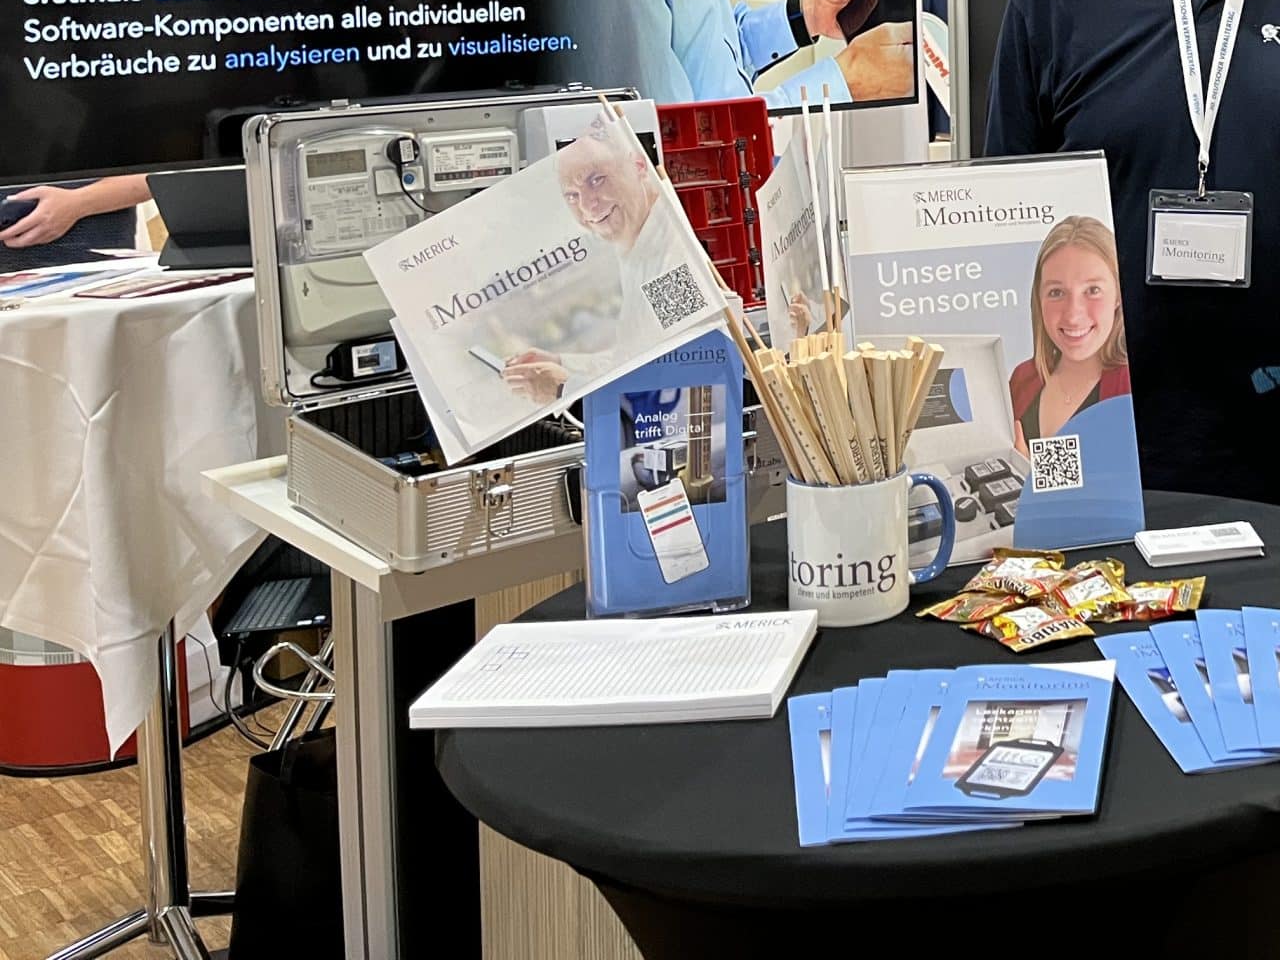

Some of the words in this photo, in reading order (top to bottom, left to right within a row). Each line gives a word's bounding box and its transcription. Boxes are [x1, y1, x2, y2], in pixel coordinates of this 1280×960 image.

[23, 13, 333, 46] Software-Komponenten
[340, 4, 382, 28] alle
[388, 3, 526, 26] individuellen
[24, 50, 180, 82] Verbräuche
[187, 54, 217, 72] zu
[224, 41, 360, 73] analysieren
[366, 38, 412, 62] und
[417, 40, 442, 59] zu
[448, 31, 578, 58] visualisieren.
[928, 188, 973, 203] MERICK
[922, 201, 1055, 228] Monitoring
[412, 234, 460, 268] MERICK
[431, 236, 588, 328] Monitoring
[877, 260, 982, 287] Unsere
[879, 288, 1018, 319] Sensoren
[635, 410, 678, 426] Analog
[635, 426, 662, 440] trifft
[665, 420, 705, 437] Digital
[790, 551, 896, 593] toring
[816, 591, 830, 599] und
[832, 586, 875, 600] kompetent
[733, 616, 793, 631] MERICK
